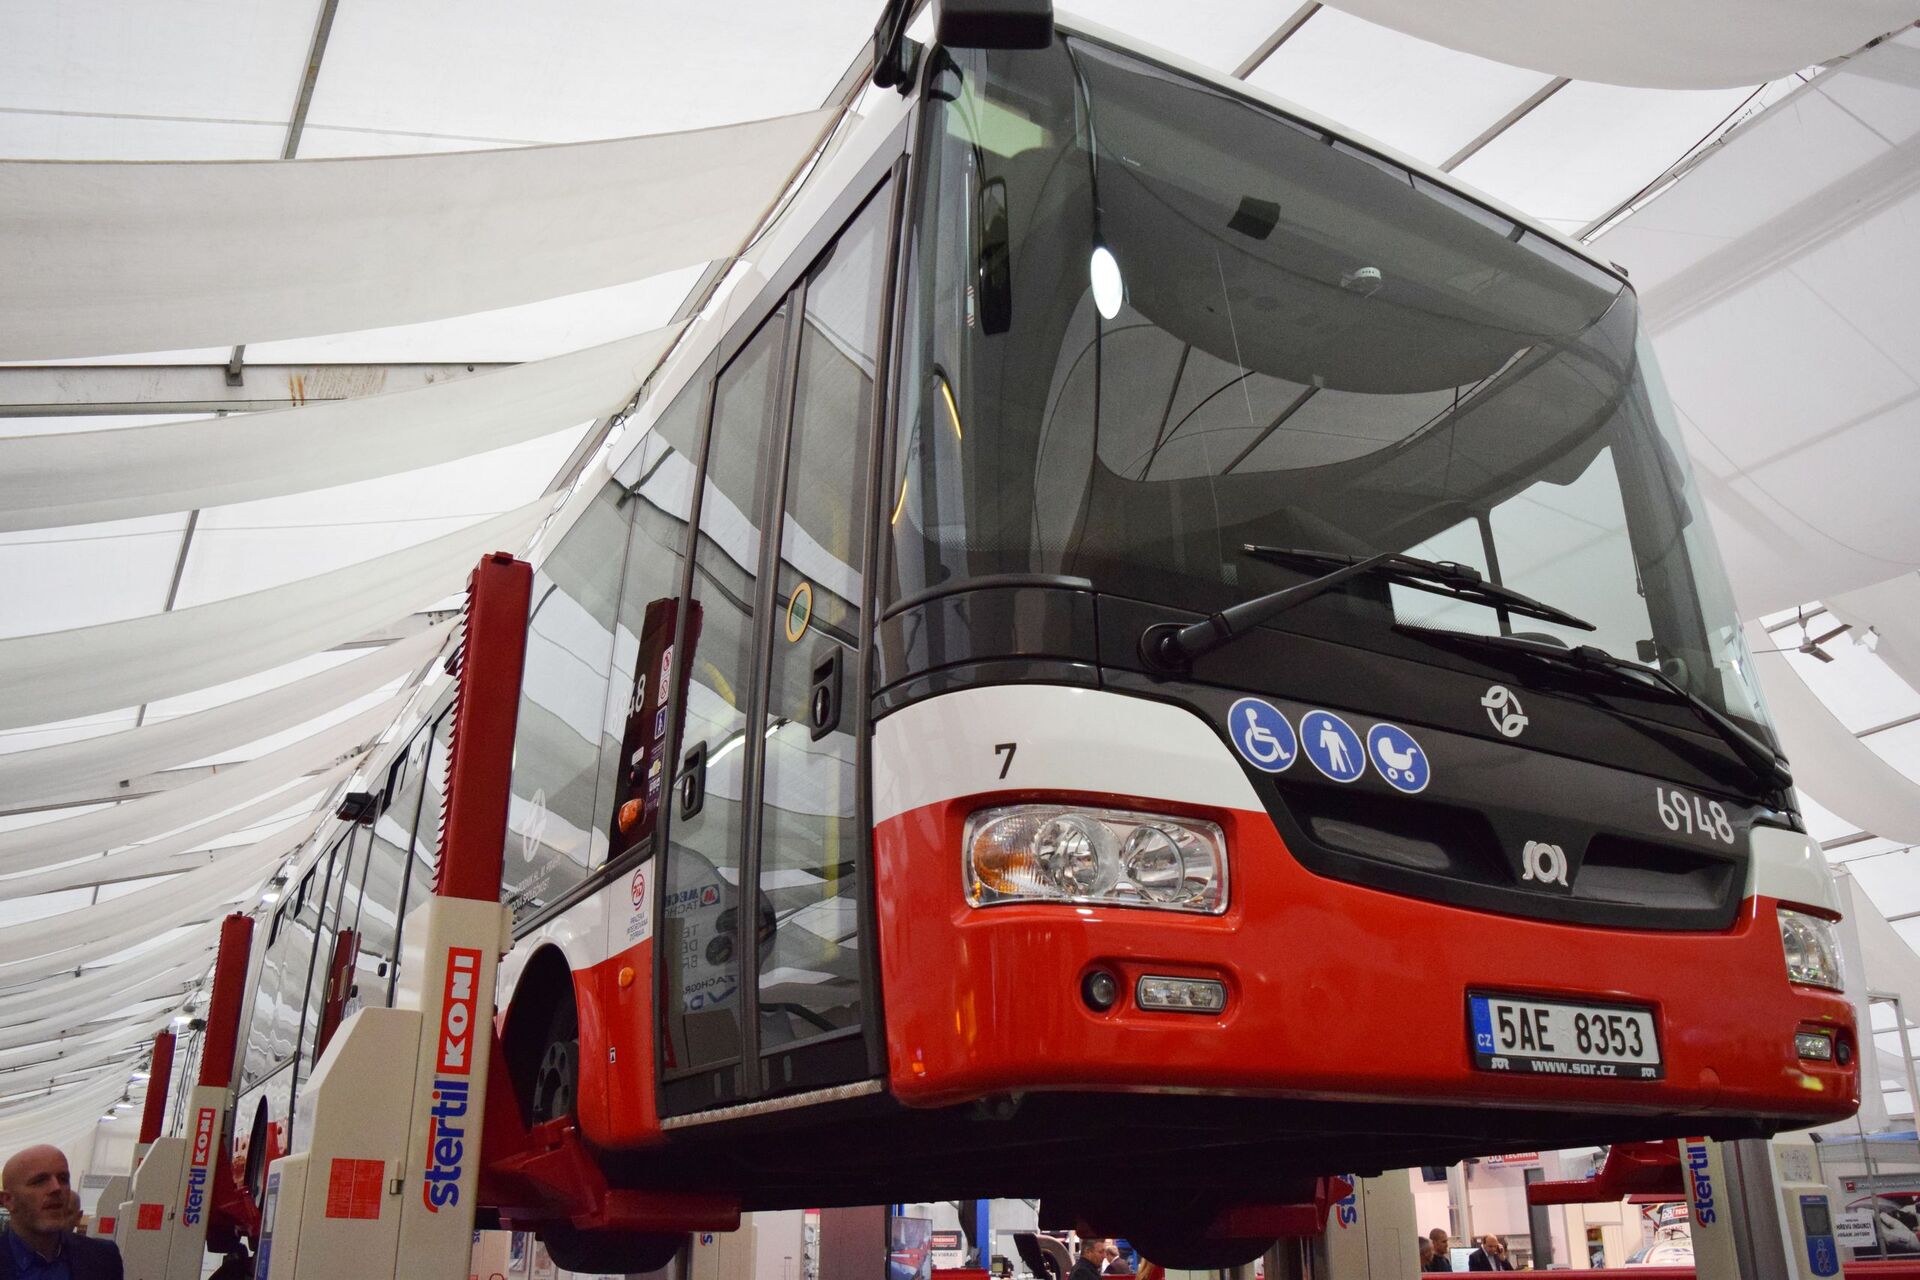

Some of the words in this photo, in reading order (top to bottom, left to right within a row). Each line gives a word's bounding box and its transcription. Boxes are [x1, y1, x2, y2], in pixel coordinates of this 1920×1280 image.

[995, 742, 1017, 780] 7
[1656, 786, 1736, 845] 6948
[444, 955, 475, 1067] KONI
[1477, 1033, 1492, 1047] CZ
[1497, 1005, 1555, 1052] 5AE
[1574, 1012, 1644, 1057] 8353
[1531, 1060, 1618, 1077] www.sor.cz
[183, 1168, 207, 1227] stertil
[195, 1111, 212, 1163] KONI
[423, 1080, 470, 1213] stertil
[1687, 1146, 1716, 1228] stertil
